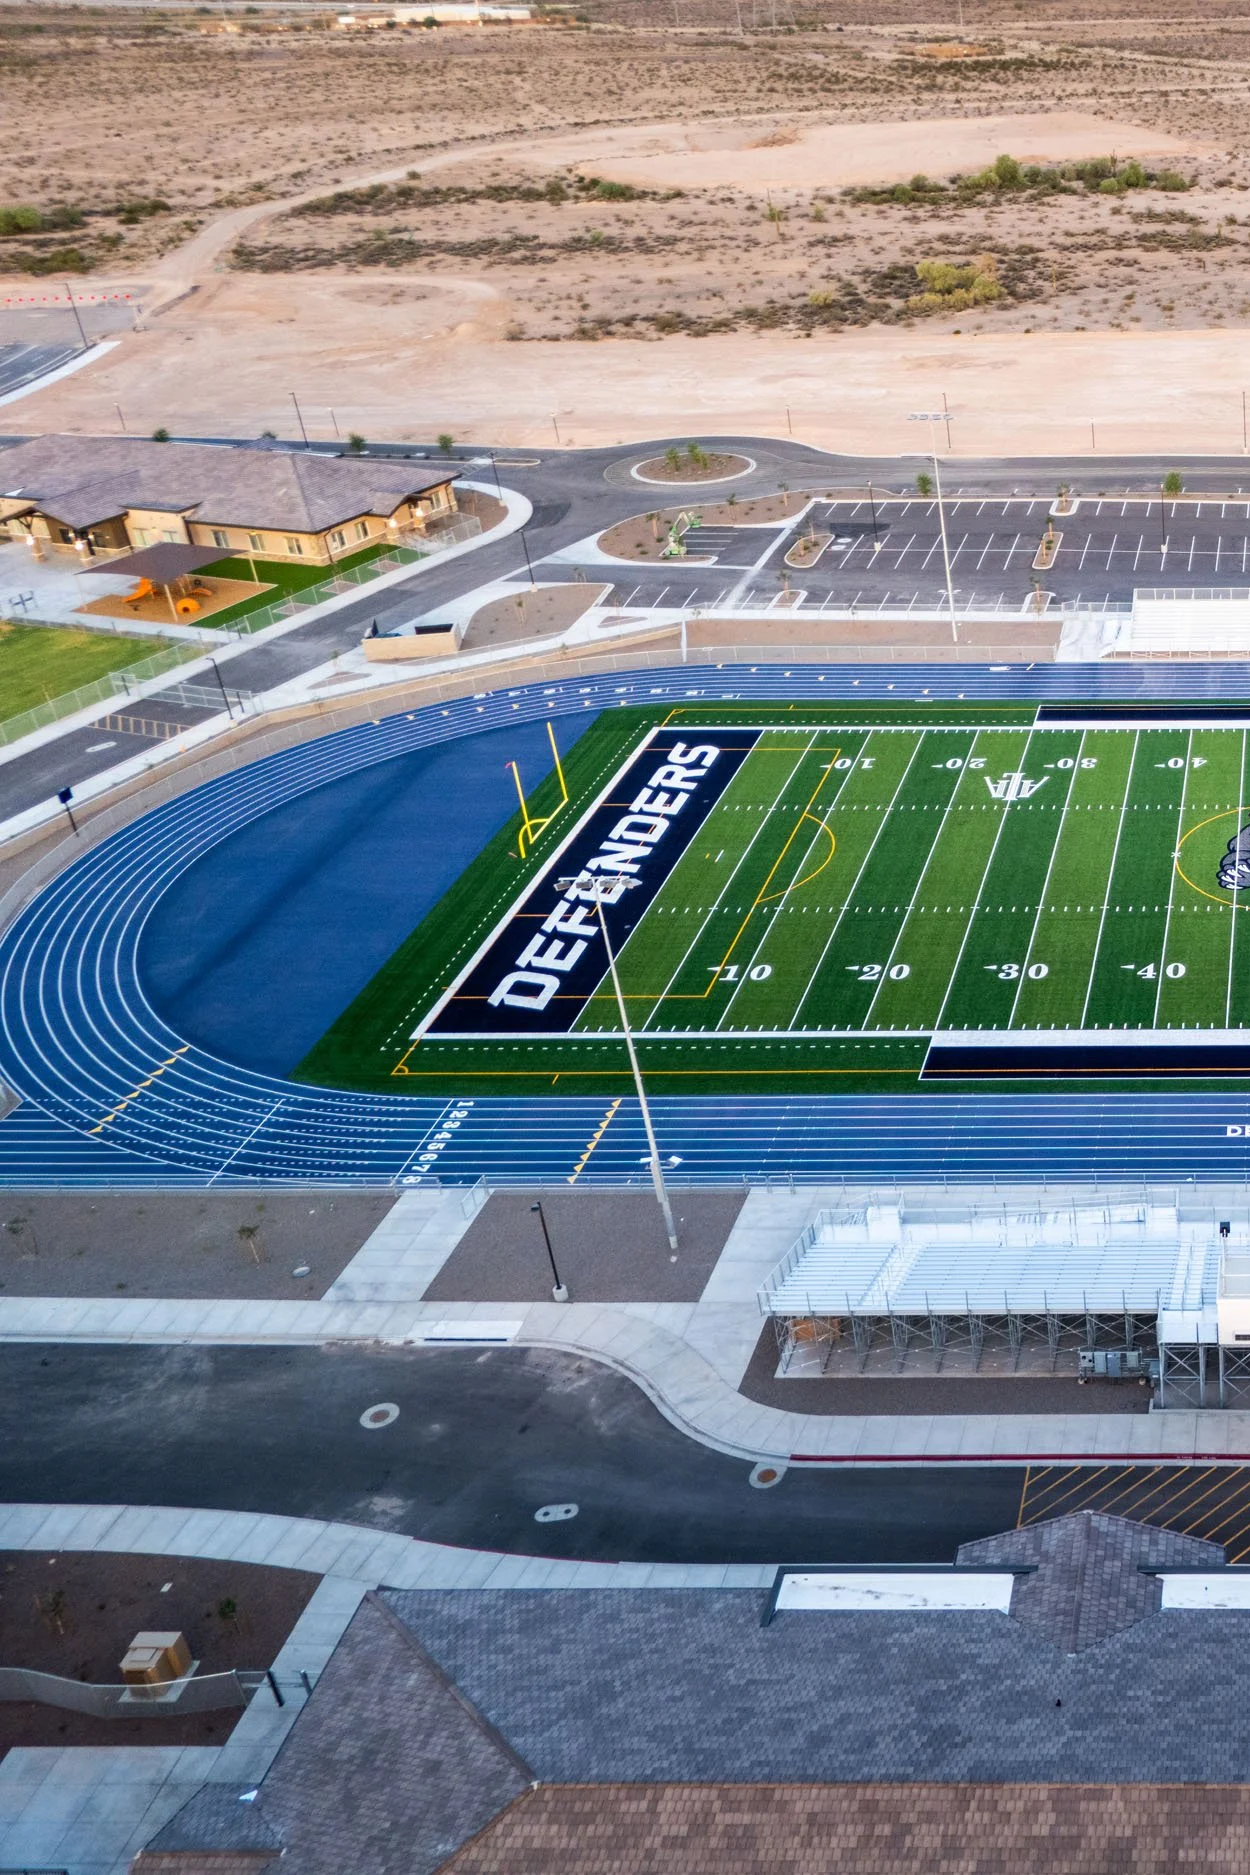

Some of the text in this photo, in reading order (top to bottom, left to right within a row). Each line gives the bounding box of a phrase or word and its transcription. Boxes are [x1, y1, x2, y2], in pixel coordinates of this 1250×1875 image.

[834, 758, 877, 769] 10
[946, 758, 987, 769] 20
[1057, 758, 1098, 769] 30
[1167, 757, 1208, 768] 40
[487, 741, 720, 1011] DEFENDERS
[719, 964, 772, 981] 10
[857, 964, 911, 981] 20
[998, 963, 1049, 979] 30
[1136, 962, 1186, 979] 40
